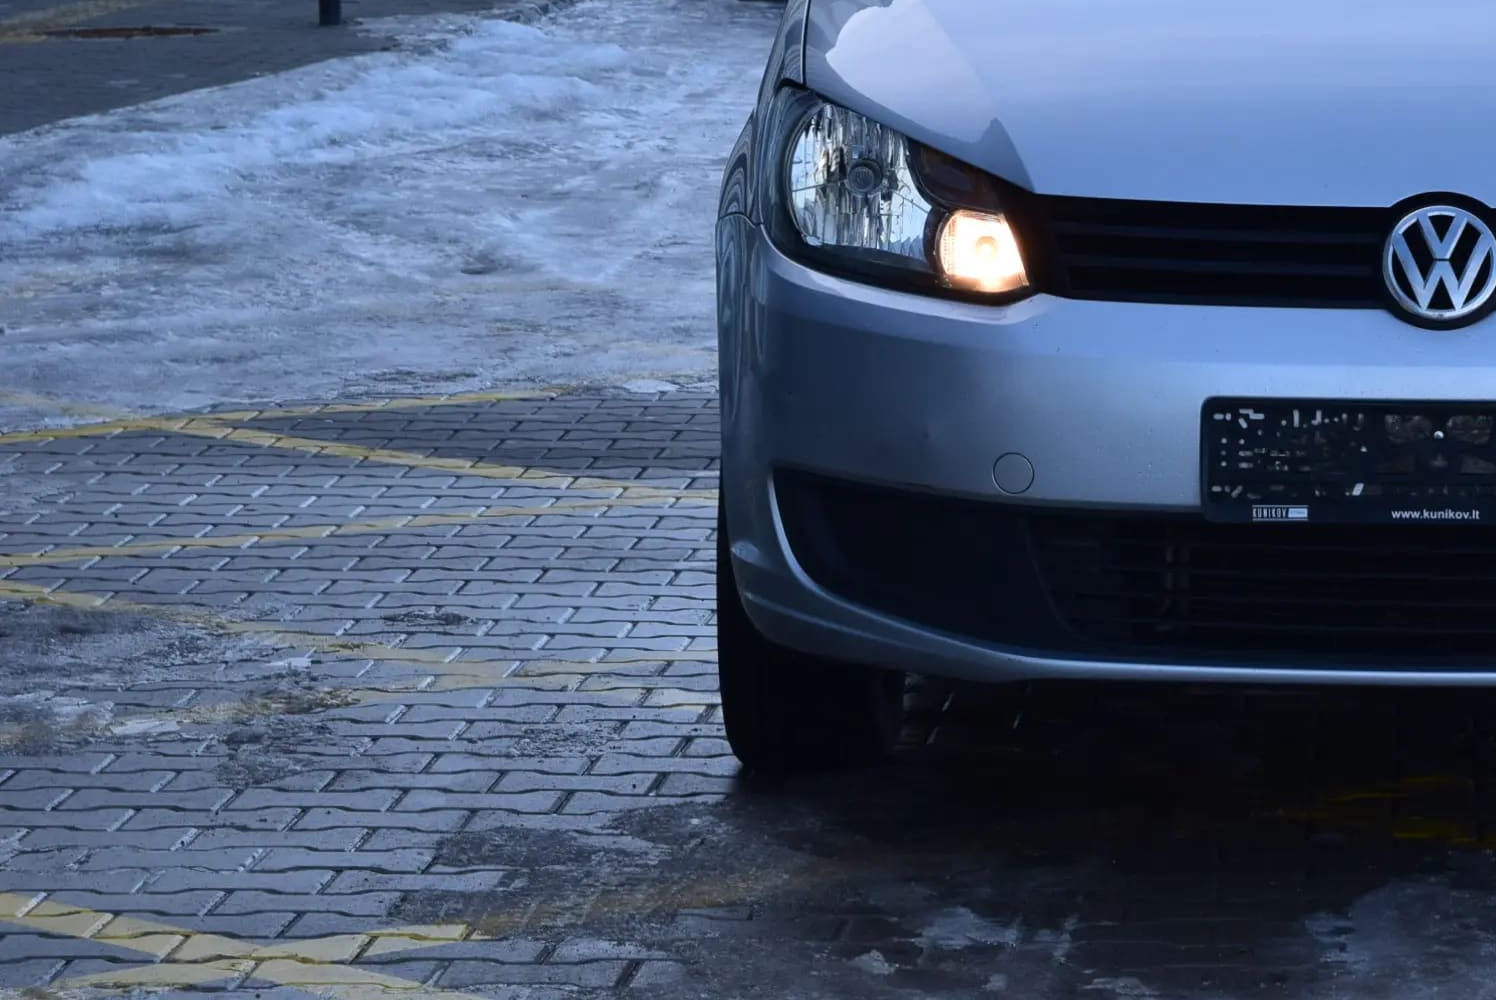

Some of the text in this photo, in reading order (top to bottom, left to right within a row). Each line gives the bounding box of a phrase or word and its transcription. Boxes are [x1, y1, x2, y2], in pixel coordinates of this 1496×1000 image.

[1389, 208, 1495, 312] VW
[1252, 508, 1287, 518] KUNIKOV
[1391, 508, 1480, 519] www.kunikov.lt
